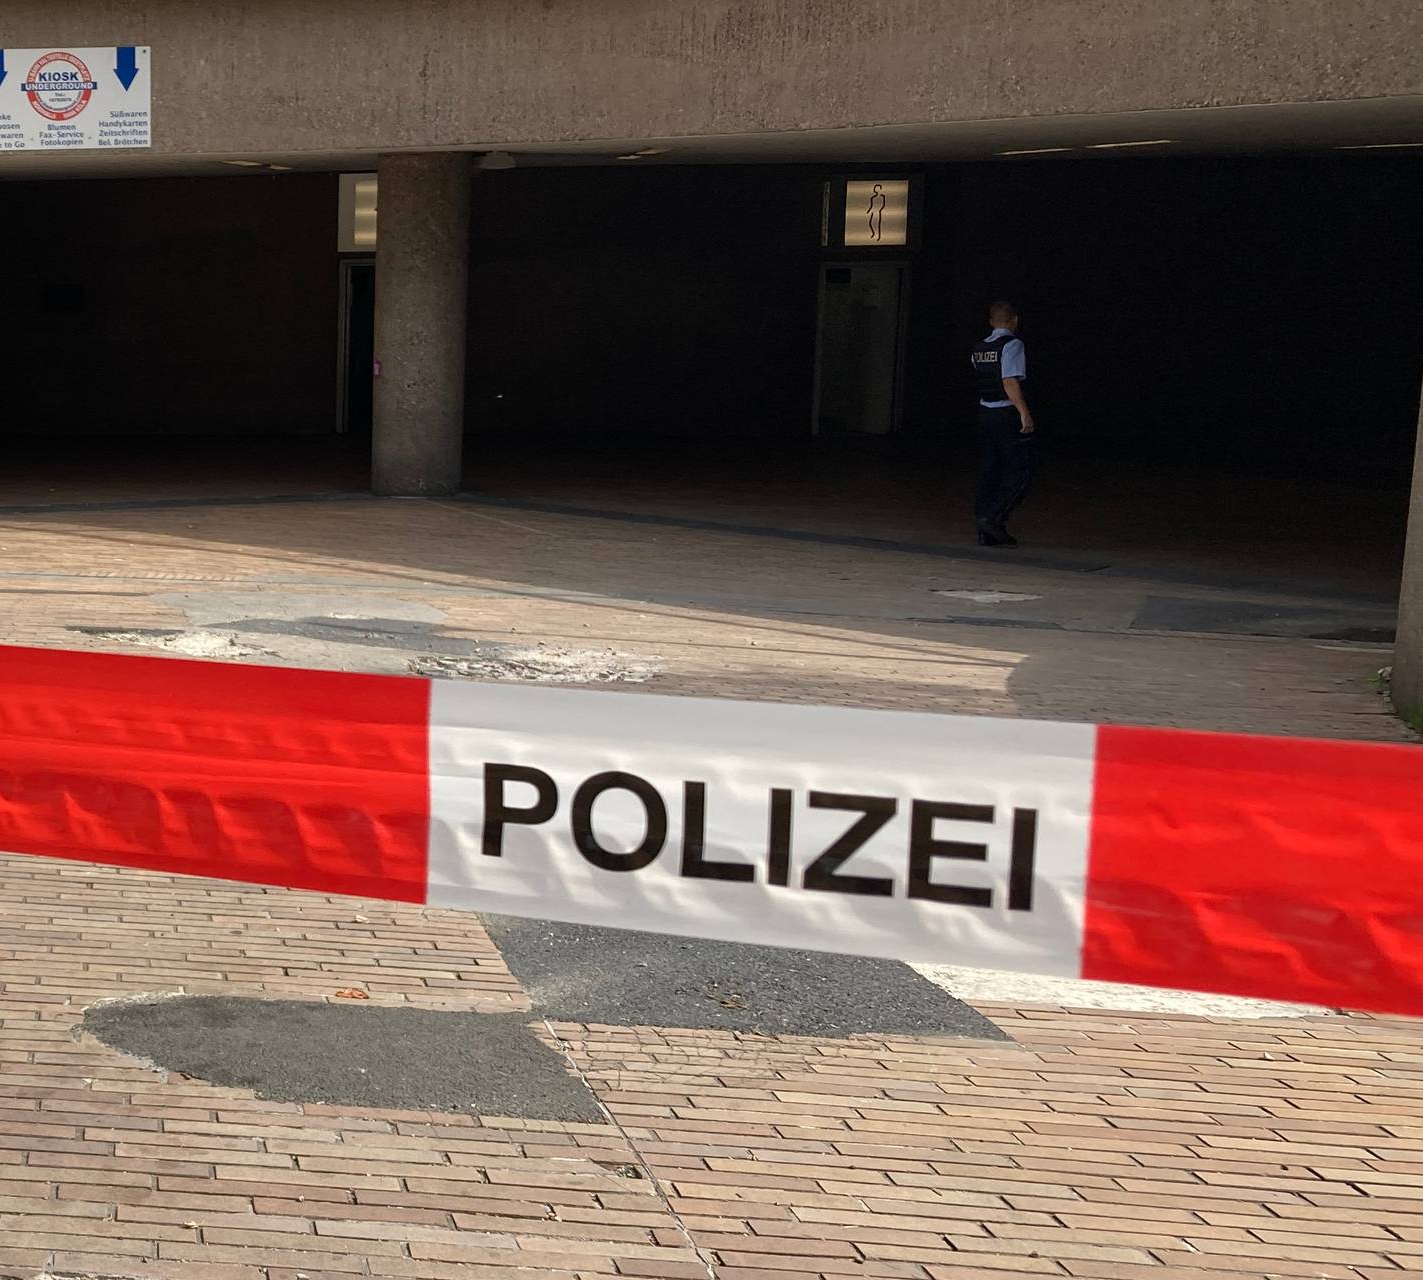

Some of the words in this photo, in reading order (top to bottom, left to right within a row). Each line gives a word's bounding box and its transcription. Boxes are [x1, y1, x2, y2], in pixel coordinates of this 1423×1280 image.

[39, 71, 79, 81] KIOSK
[25, 82, 94, 91] UNDERGROUND
[109, 110, 148, 118] Süßwaren
[47, 123, 76, 131] Blumen
[98, 119, 148, 128] Handykarten
[98, 128, 148, 137] Zeitschriften
[114, 138, 148, 146] Brötchen
[480, 762, 1038, 912] POLIZEI
